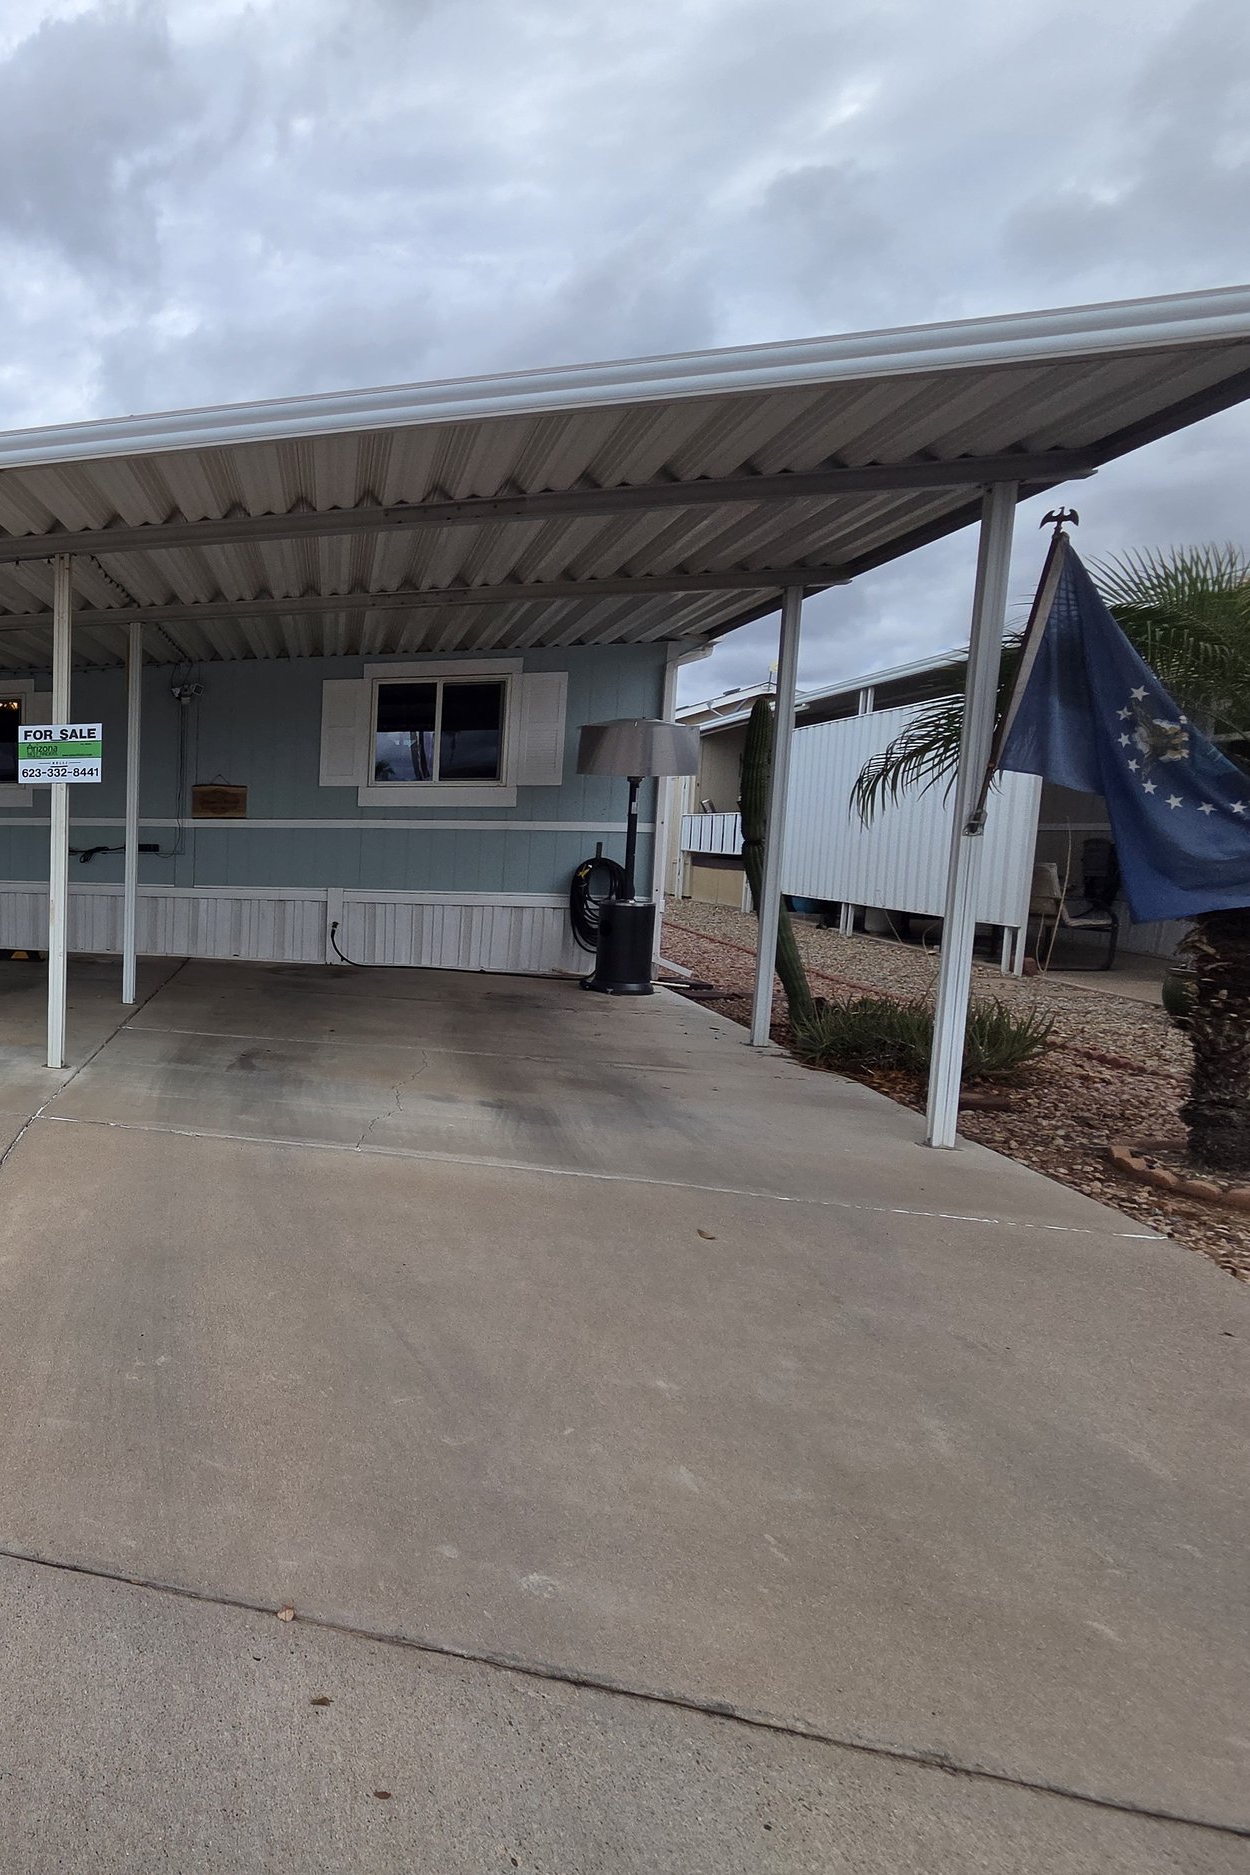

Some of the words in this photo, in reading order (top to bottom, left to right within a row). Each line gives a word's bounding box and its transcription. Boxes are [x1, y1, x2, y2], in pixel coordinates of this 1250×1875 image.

[24, 729, 53, 741] FOR
[60, 728, 96, 740] SALE
[27, 743, 58, 752] Arizona
[22, 768, 99, 778] 623-332-8441
